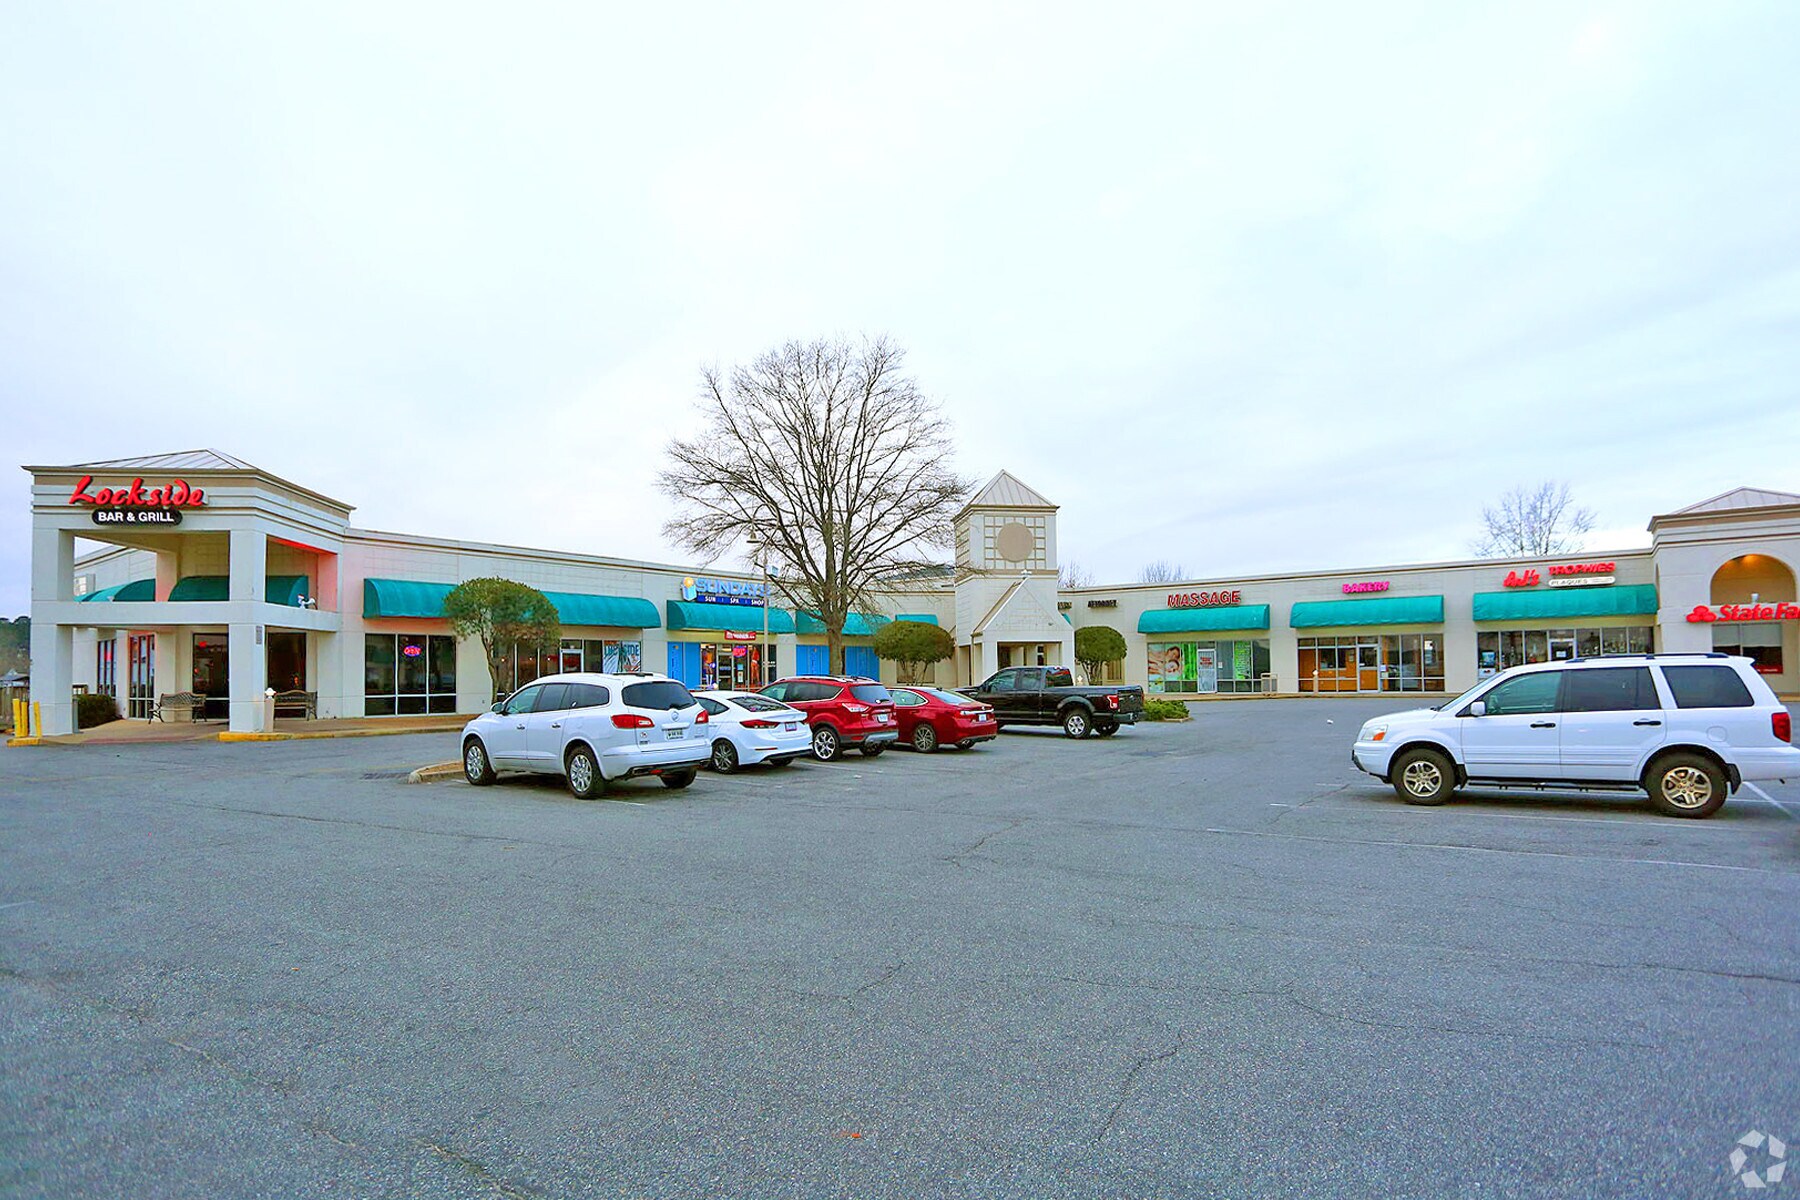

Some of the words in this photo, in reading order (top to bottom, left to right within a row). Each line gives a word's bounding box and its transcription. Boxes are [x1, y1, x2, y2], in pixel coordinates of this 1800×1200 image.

[69, 475, 204, 506] Lockside
[98, 512, 123, 522] BAR
[126, 512, 135, 522] &
[138, 512, 174, 522] GRILL
[1548, 562, 1617, 576] TROPHIES
[1342, 581, 1390, 594] BAKERY
[1167, 590, 1241, 607] MASSAGE
[1718, 604, 1774, 621] State
[1775, 602, 1800, 620] Fa
